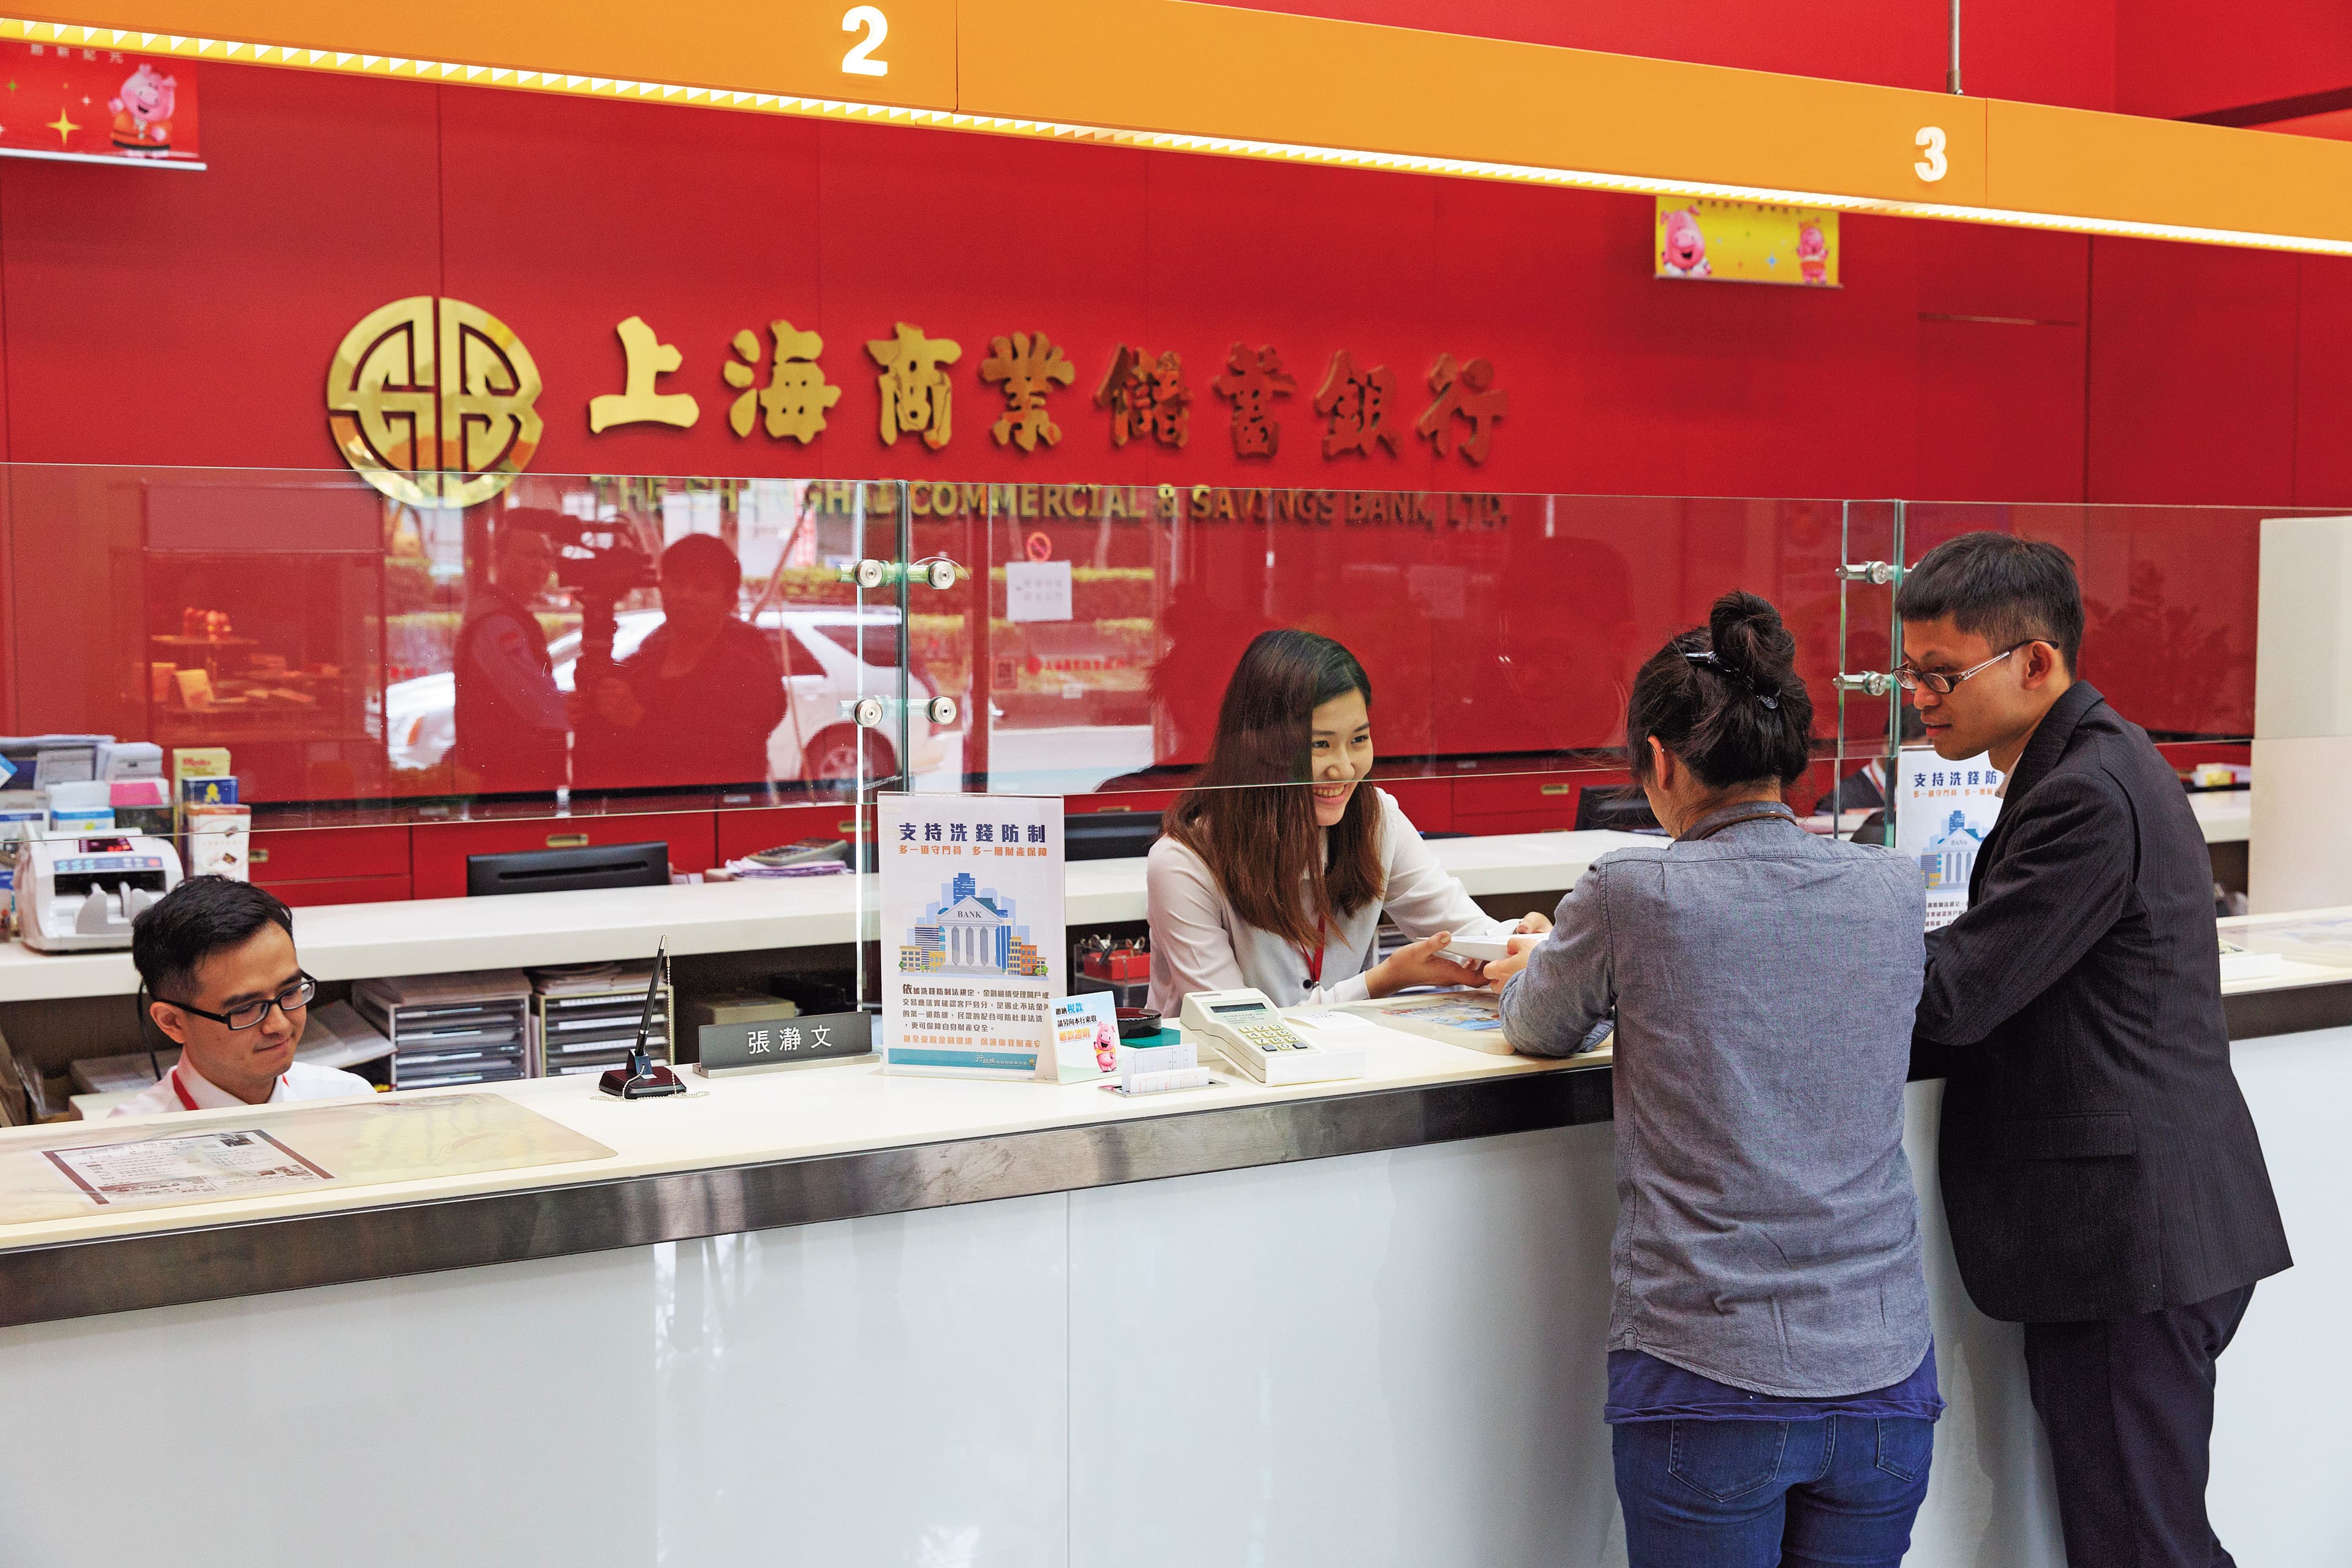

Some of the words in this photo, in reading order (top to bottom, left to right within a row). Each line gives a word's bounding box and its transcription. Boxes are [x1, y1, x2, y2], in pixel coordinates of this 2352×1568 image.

[842, 6, 888, 77] 2
[1914, 126, 1948, 183] 3
[589, 315, 1509, 466] 上海商業儲蓄銀行
[909, 480, 1146, 518] COMMERCIAL
[1158, 483, 1180, 518] &
[1191, 484, 1334, 519] SAVINGS
[1914, 771, 1997, 787] 支持洗錢防
[899, 823, 1046, 843] 支持洗錢防制
[899, 845, 962, 855] 多一道守門員
[972, 846, 1048, 856] 多一層財產保障
[1055, 1002, 1084, 1015] 繳納稅款
[1057, 1015, 1097, 1028] 請另向本行索取
[747, 1025, 832, 1054] 張瀞文
